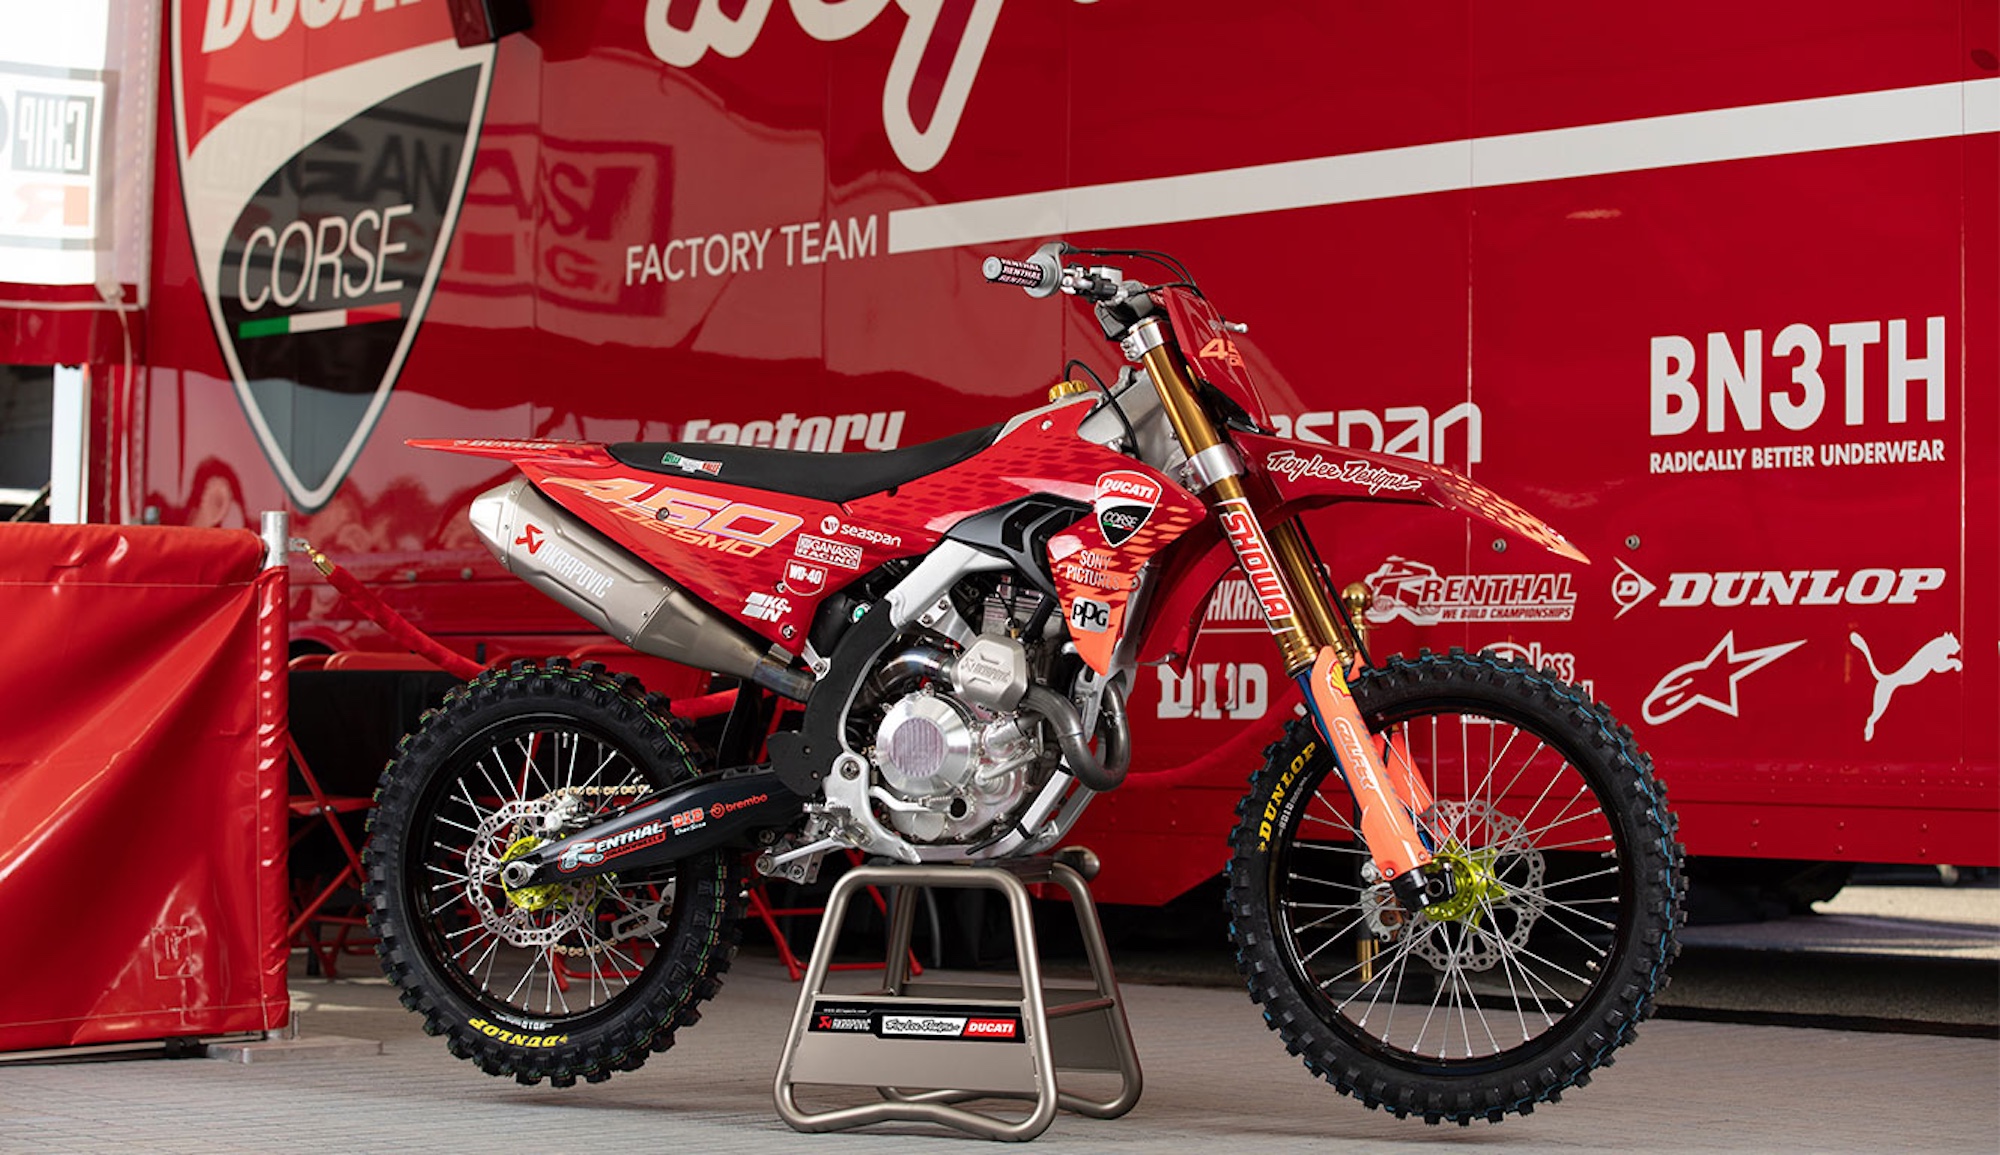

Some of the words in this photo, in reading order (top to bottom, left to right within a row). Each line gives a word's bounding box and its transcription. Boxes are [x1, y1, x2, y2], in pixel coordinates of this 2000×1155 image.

[240, 205, 412, 312] CORSE
[625, 228, 772, 286] FACTORY
[780, 214, 877, 266] TEAM
[1650, 316, 1945, 436] BN3TH
[1650, 448, 1747, 474] RADICALLY
[1751, 445, 1815, 469] BETTER
[1820, 439, 1945, 466] UNDERWEAR
[1101, 478, 1155, 499] DUCATI
[541, 477, 804, 547] 450
[1103, 511, 1139, 528] CORSE
[609, 506, 765, 558] DESMO
[840, 523, 901, 547] seaspan
[788, 565, 823, 585] WD-40
[1080, 550, 1111, 571] SONY
[1219, 511, 1294, 621] SHOWA
[1065, 565, 1120, 590] PICTURES
[1419, 573, 1577, 606] RENTHAL
[1658, 567, 1946, 607] DUNLOP
[1442, 608, 1457, 619] WE
[1460, 607, 1487, 619] BUILD
[1490, 606, 1572, 619] CHAMPIONSHIPS
[725, 794, 768, 812] brembo
[1258, 741, 1316, 842] DUNLOP
[468, 1018, 560, 1048] DUNLOP
[968, 1021, 1014, 1033] DUCATI
